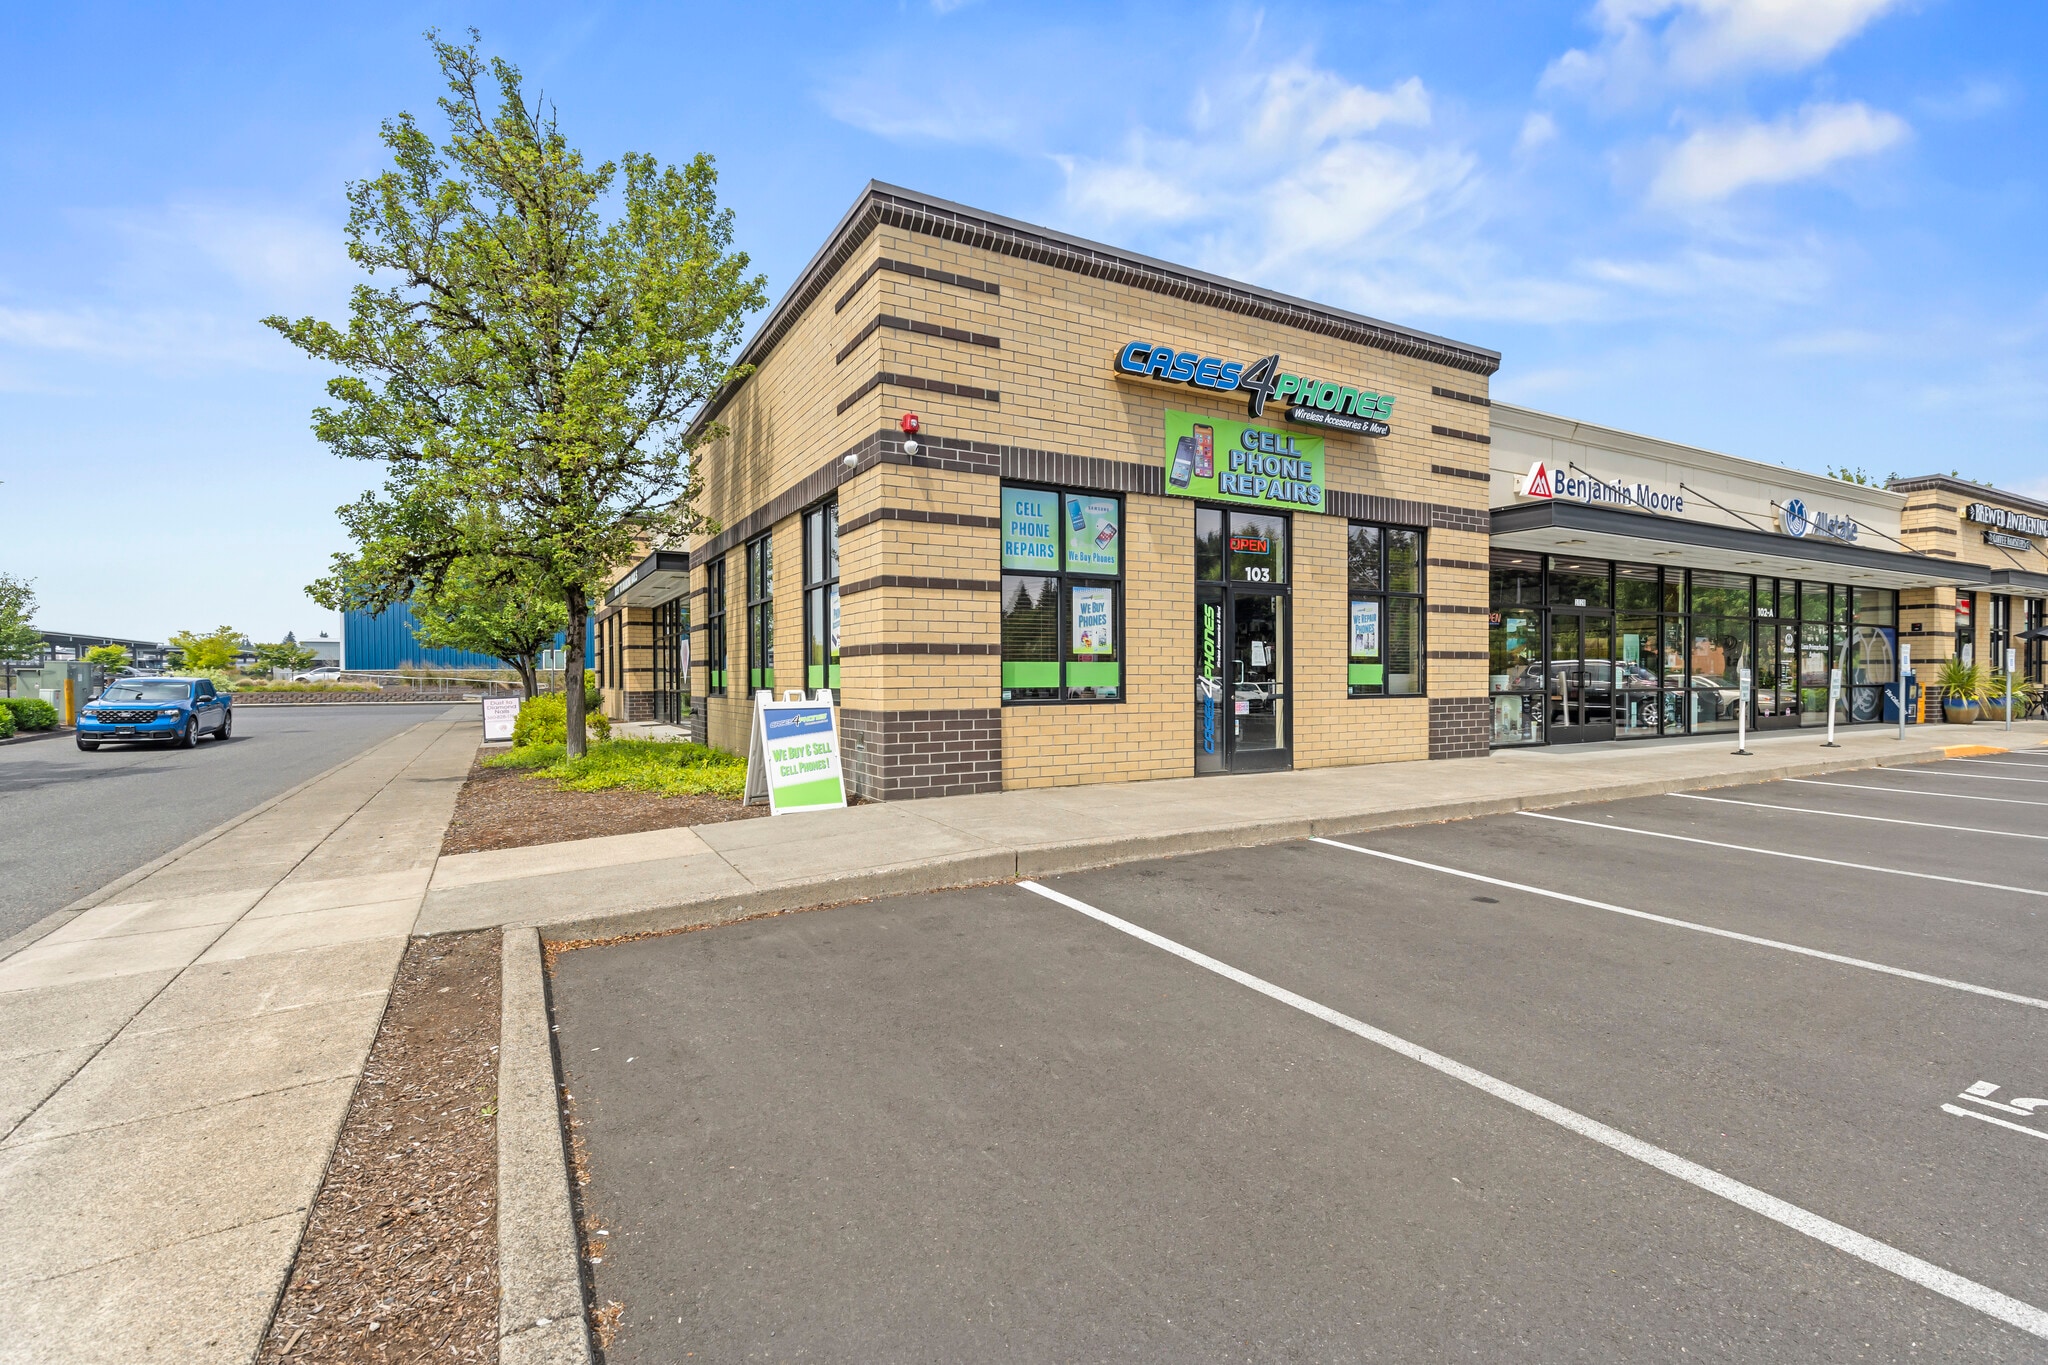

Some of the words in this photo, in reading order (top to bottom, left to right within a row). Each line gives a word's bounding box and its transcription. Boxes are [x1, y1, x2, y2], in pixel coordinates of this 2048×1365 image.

[1294, 408, 1324, 422] Wireless
[1324, 414, 1362, 430] Accessories
[1362, 421, 1369, 431] &
[1369, 423, 1388, 435] More!
[1241, 429, 1301, 458] CELL
[1229, 449, 1312, 482] PHONE
[1218, 471, 1321, 506] REPAIRS
[1554, 469, 1632, 503] Benjamin
[1636, 483, 1684, 512] Moore
[1015, 501, 1043, 518] CELL
[1087, 505, 1110, 513] SAMSUNG
[1975, 504, 2006, 526] BREWED
[1011, 521, 1050, 538] PHONE
[1813, 511, 1858, 541] Allstate
[1005, 541, 1055, 558] REPAIRS
[1230, 538, 1267, 553] OPEN
[1068, 550, 1079, 561] We
[1080, 552, 1091, 564] Buy
[1093, 553, 1115, 564] Phones
[1245, 567, 1270, 582] 103
[1080, 603, 1092, 614] WE
[1092, 602, 1105, 613] BUY
[1757, 608, 1774, 617] 102-A
[1078, 614, 1107, 628] PHONES
[772, 749, 787, 762] WE
[787, 746, 804, 760] BUY
[812, 742, 832, 755] SELL
[780, 765, 799, 777] CELL
